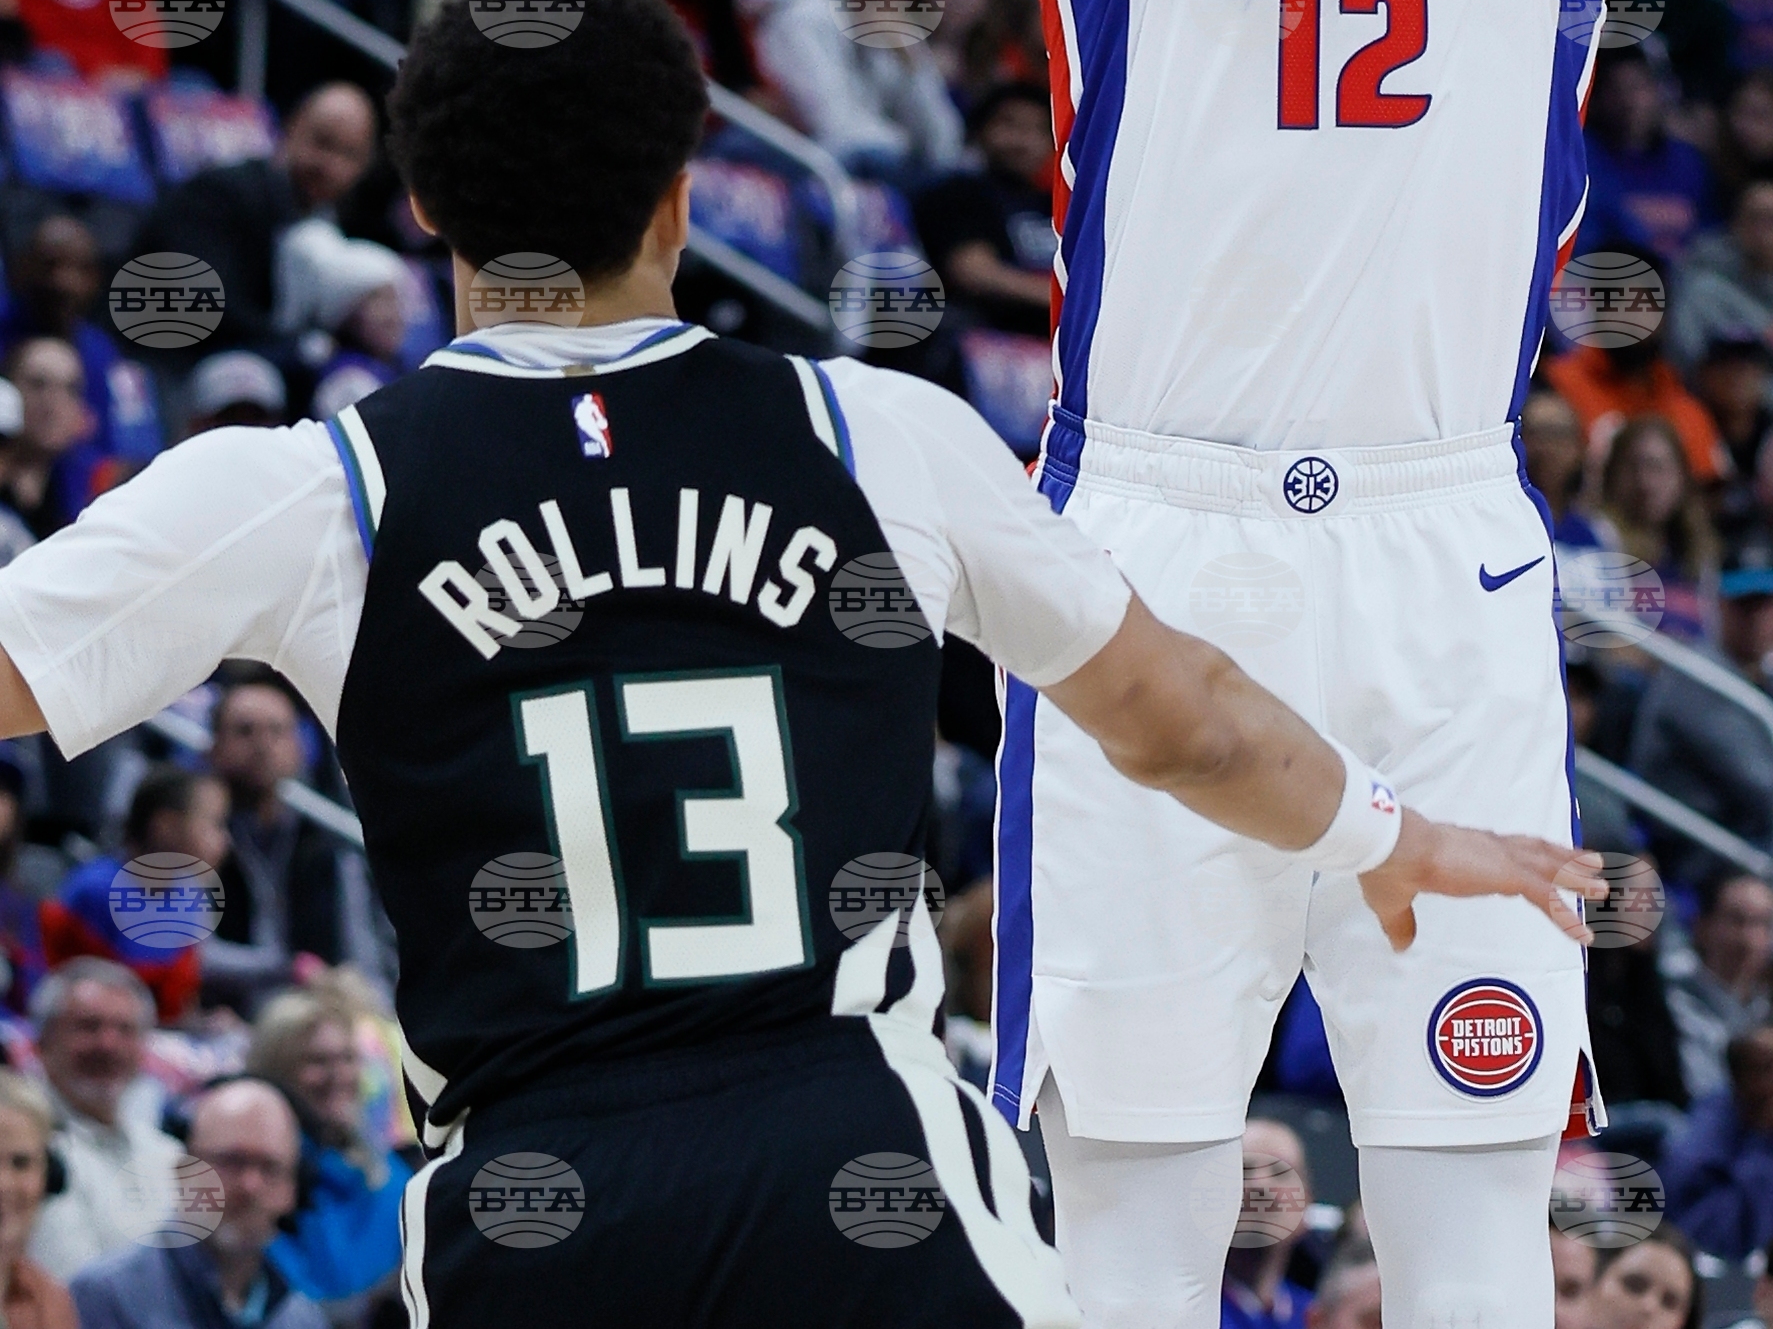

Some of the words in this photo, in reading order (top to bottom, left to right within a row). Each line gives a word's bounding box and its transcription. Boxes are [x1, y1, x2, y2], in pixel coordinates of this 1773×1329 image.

[418, 487, 838, 660] ROLLINS
[509, 664, 816, 1003] 13
[1451, 1017, 1521, 1037] DETROIT
[1451, 1036, 1523, 1057] PISTONS
